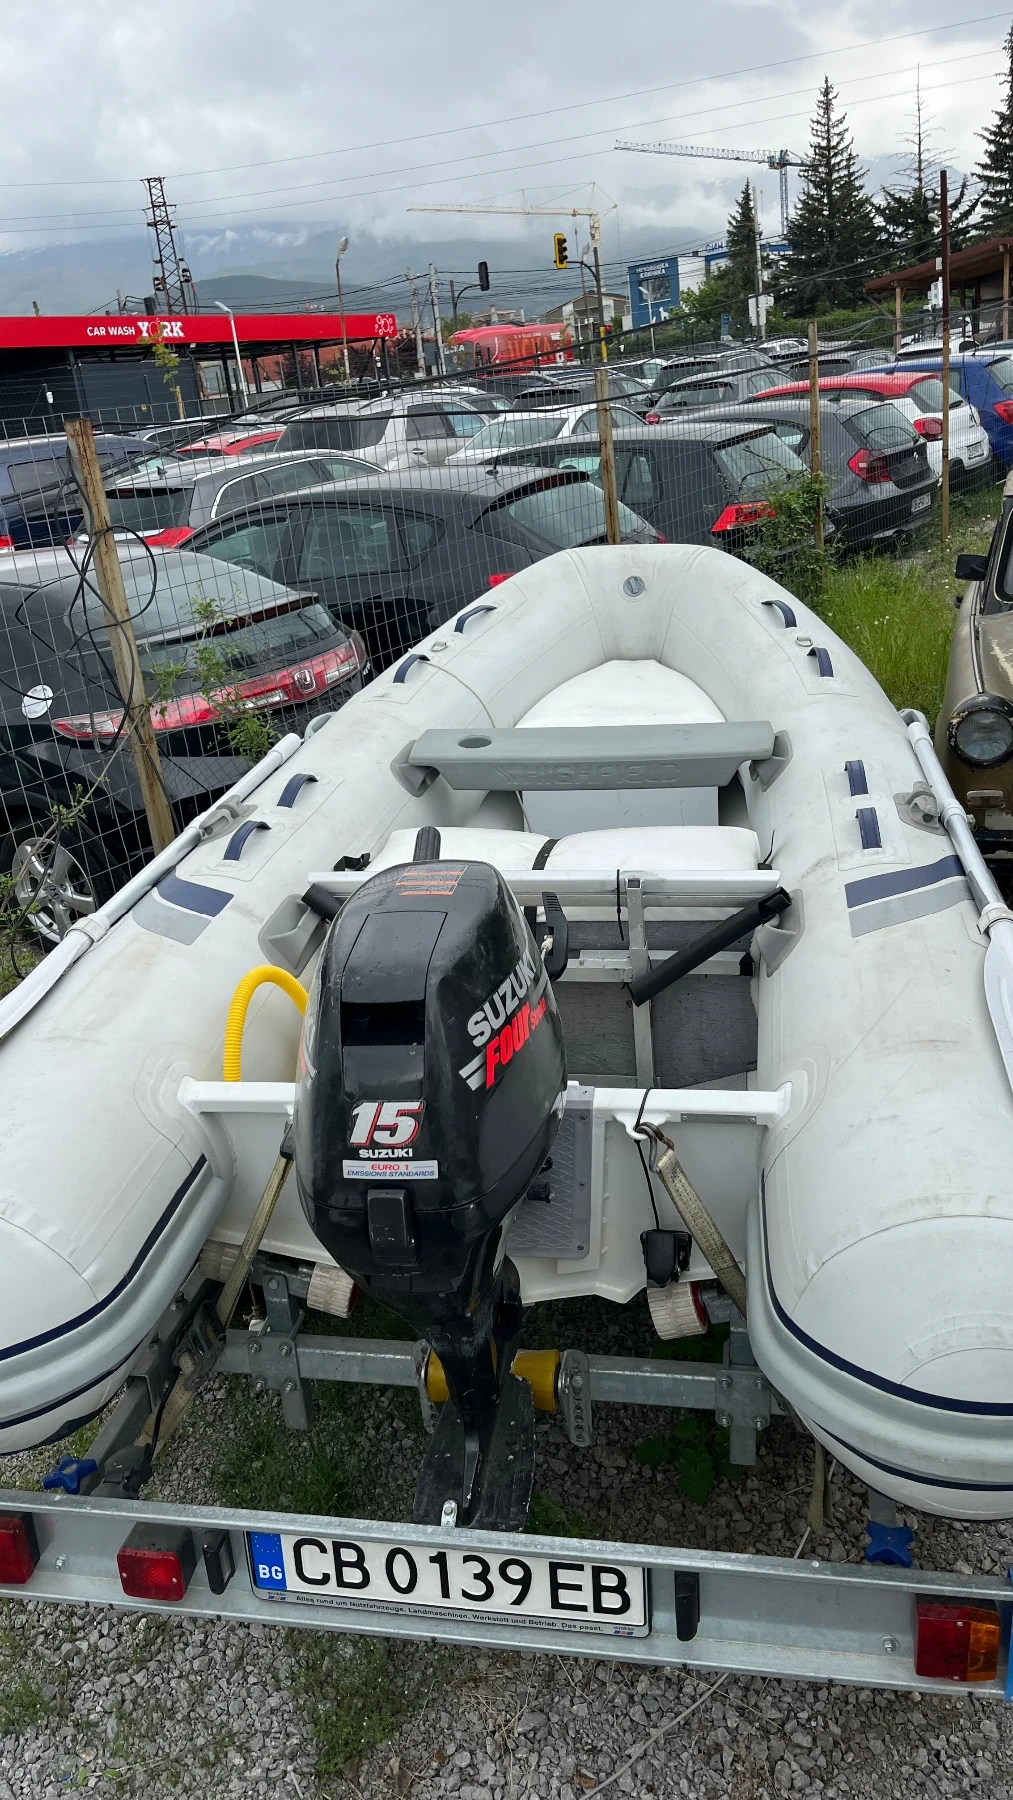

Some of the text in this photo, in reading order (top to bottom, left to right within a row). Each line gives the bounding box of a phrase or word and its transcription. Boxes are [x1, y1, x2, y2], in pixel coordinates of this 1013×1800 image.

[86, 320, 186, 339] CAR WASH YORK
[521, 763, 681, 786] HIGHFIELD
[467, 948, 537, 1048] SUZUKI
[349, 1101, 424, 1147] 15
[358, 1148, 413, 1159] SUZUKI
[347, 1170, 387, 1178] EMISSIONS
[371, 1163, 400, 1171] EURO
[258, 1564, 283, 1580] BG
[292, 1537, 631, 1616] CB 0139 EB
[296, 1595, 315, 1603] Alles
[472, 1614, 510, 1623] Werkstatt
[579, 1624, 604, 1633] passt.
